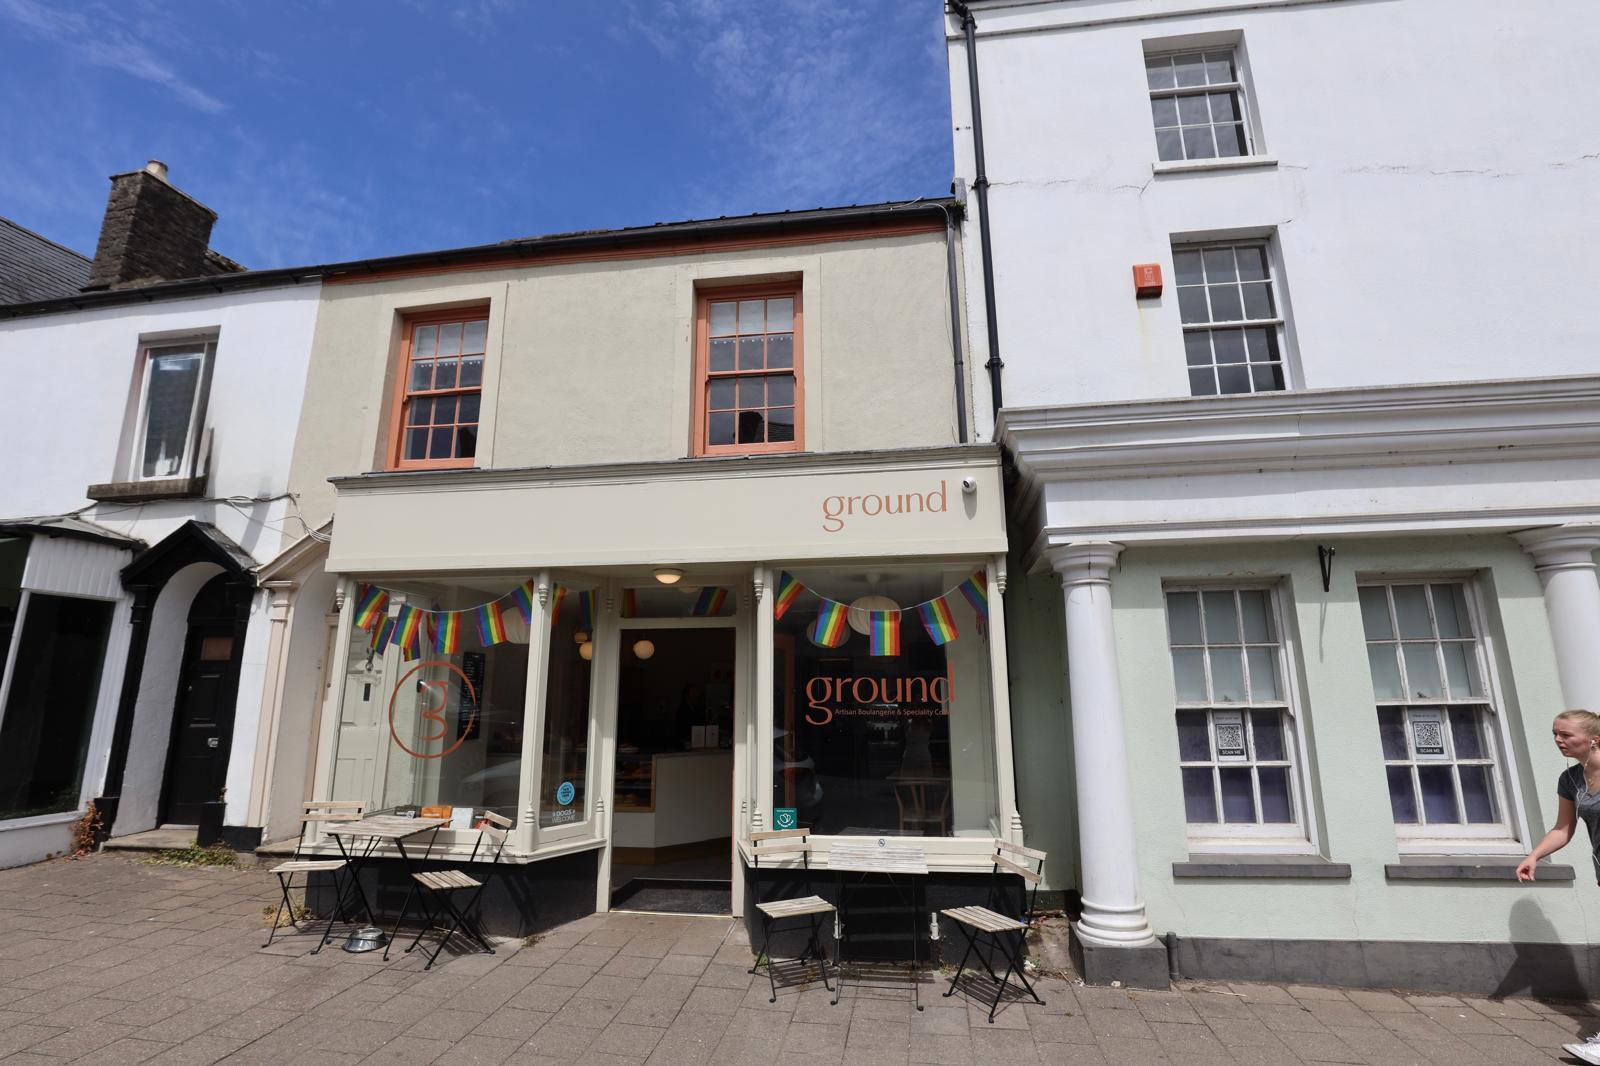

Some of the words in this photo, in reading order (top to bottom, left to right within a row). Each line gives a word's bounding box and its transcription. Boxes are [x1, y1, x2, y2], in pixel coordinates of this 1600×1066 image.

[822, 480, 947, 533] ground
[805, 661, 955, 726] ground
[834, 708, 857, 716] Artisan
[903, 708, 933, 717] Speciality
